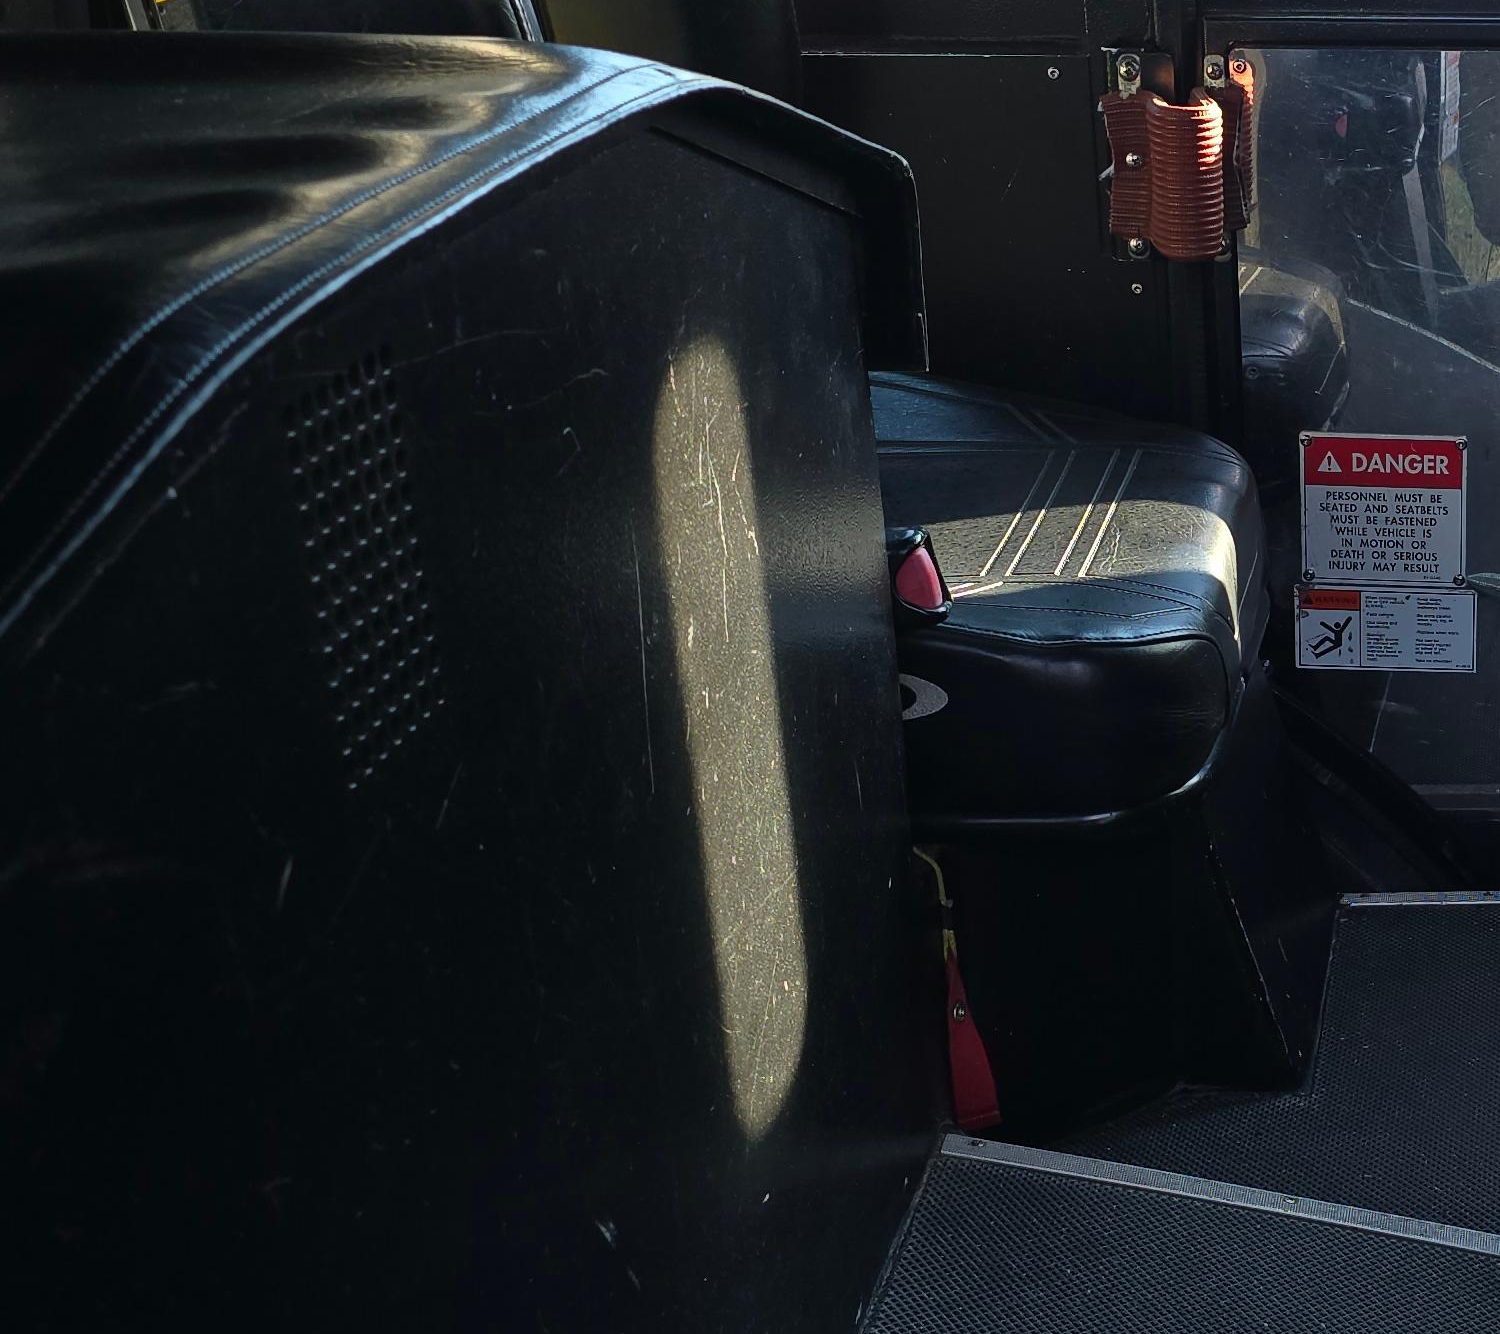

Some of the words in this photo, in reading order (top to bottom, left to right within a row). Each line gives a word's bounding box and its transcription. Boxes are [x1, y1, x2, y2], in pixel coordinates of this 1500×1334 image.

[1352, 453, 1450, 475] DANGER
[1326, 491, 1387, 502] PERSONNEL
[1395, 494, 1423, 503] MUST
[1431, 495, 1442, 503] BE
[1319, 503, 1357, 513] SEATED
[1364, 504, 1388, 514] AND
[1396, 505, 1448, 516] SEATBELTS
[1330, 515, 1358, 525] MUST
[1366, 516, 1378, 525] BE
[1385, 517, 1437, 527] FASTENED
[1335, 527, 1368, 537] WHILE
[1375, 528, 1415, 538] VEHICLE
[1423, 529, 1432, 538] IS
[1342, 539, 1352, 547] IN
[1360, 540, 1404, 549] MOTION
[1411, 541, 1426, 549] OR
[1331, 549, 1364, 560] DEATH
[1372, 551, 1386, 560] OR
[1394, 552, 1438, 561] SERIOUS
[1329, 561, 1366, 570] INJURY
[1373, 561, 1396, 572] MAY
[1404, 563, 1439, 573] RESULT
